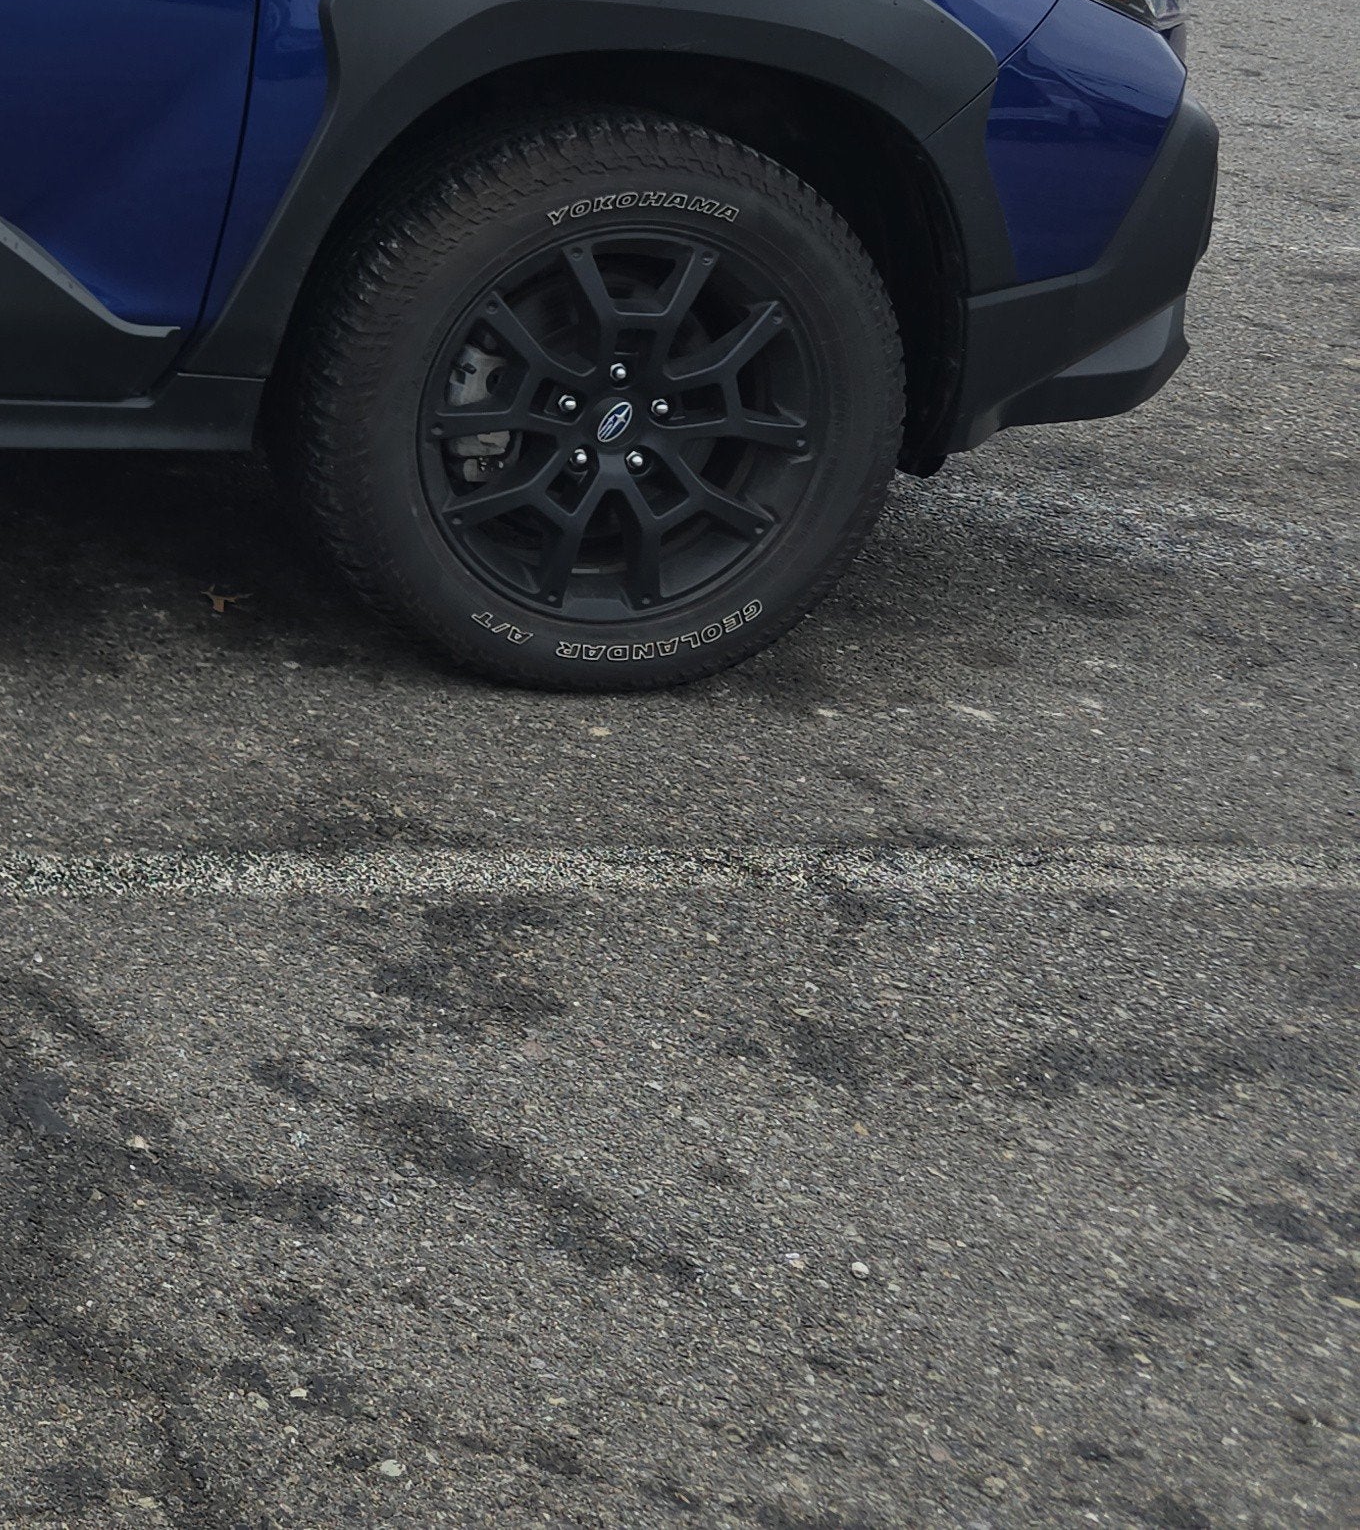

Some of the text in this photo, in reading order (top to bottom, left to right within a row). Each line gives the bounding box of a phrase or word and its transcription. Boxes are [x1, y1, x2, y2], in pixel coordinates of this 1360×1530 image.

[547, 191, 739, 226] YOKOHAMA
[471, 598, 764, 661] GEOLANDAR A/T
